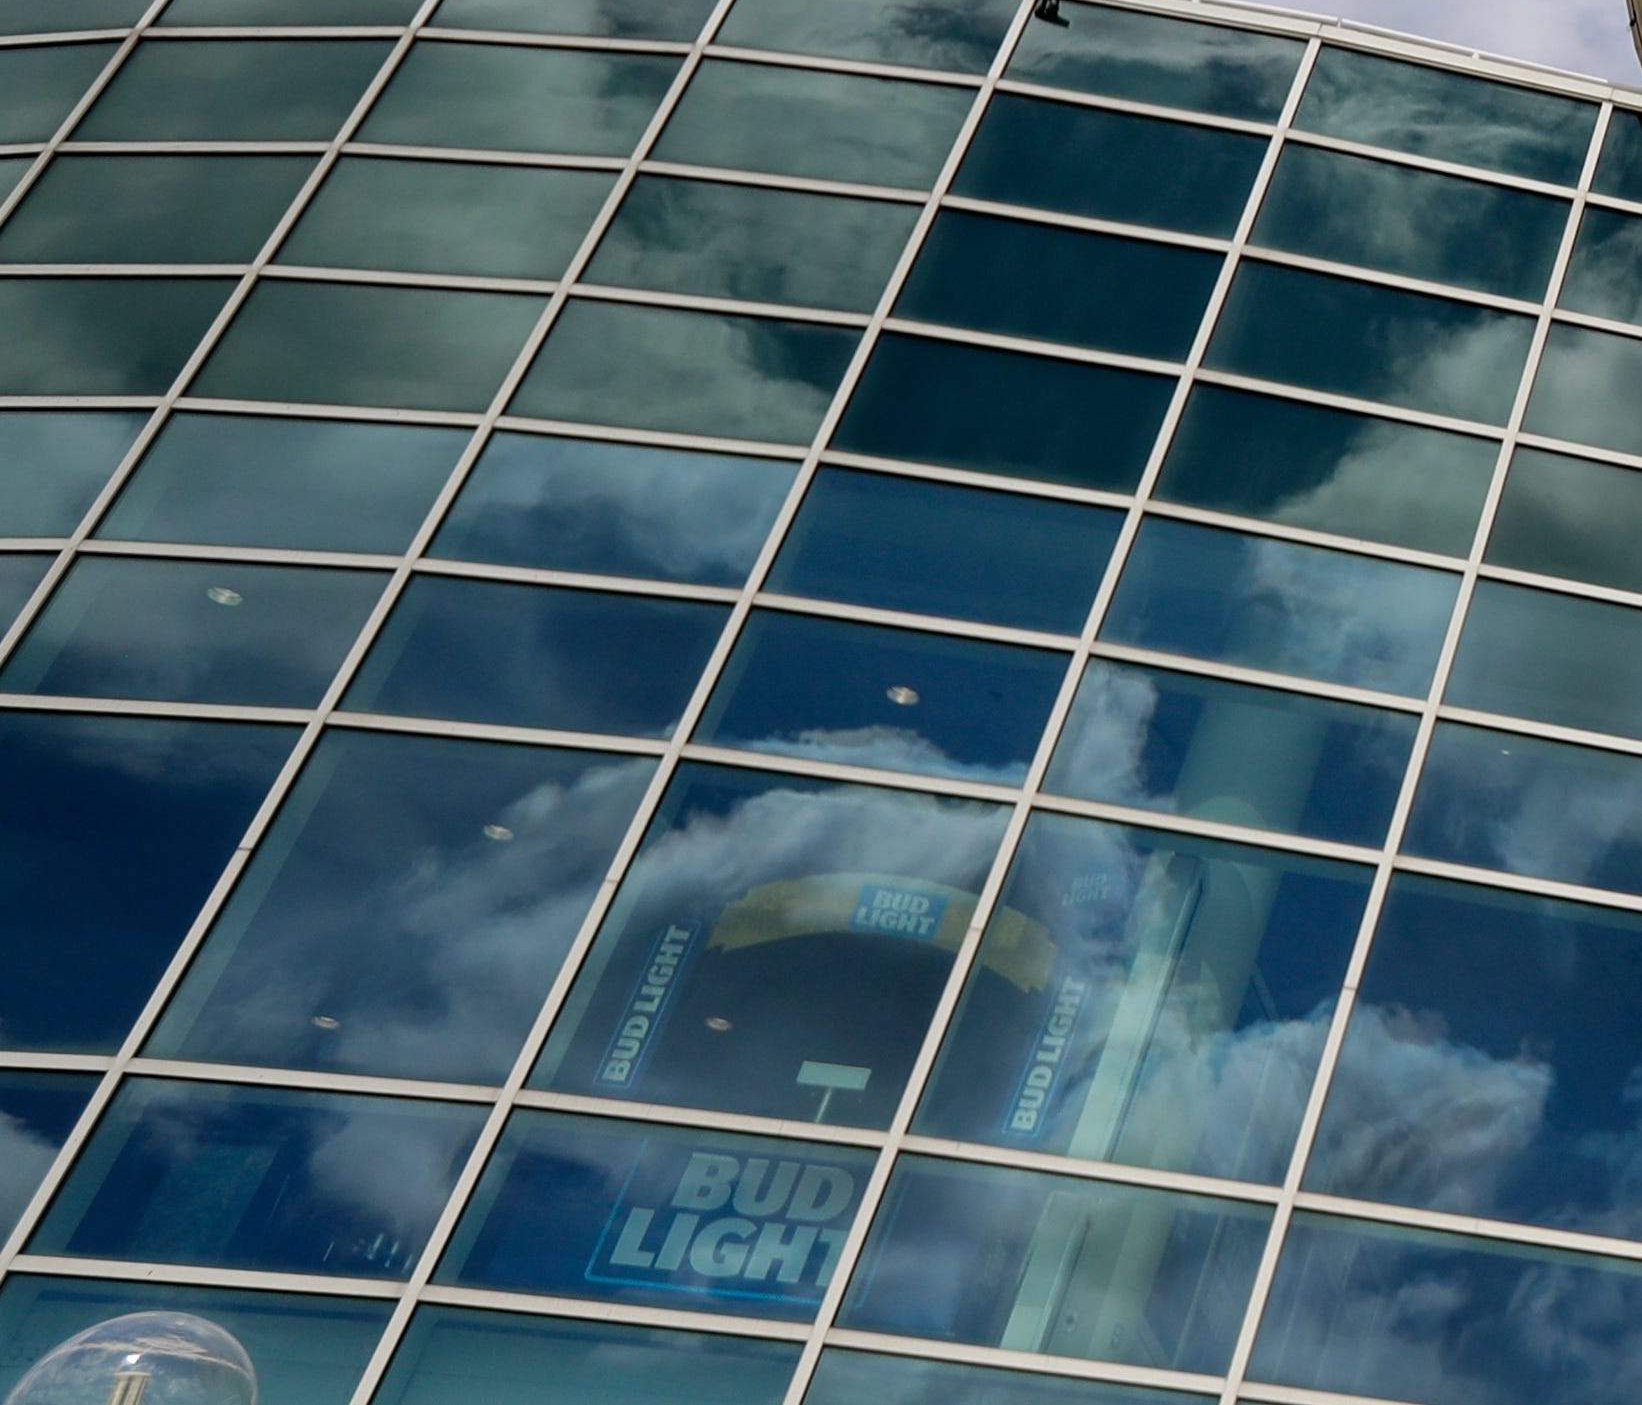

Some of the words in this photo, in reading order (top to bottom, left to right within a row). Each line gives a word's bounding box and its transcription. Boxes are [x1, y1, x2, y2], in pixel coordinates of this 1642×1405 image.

[855, 905, 936, 935] LIGHT
[872, 889, 931, 914] BUD
[602, 1015, 650, 1082] BUD
[633, 924, 691, 1013] LIGHT
[1010, 1065, 1053, 1131] BUD
[1035, 975, 1086, 1064] LIGHT
[671, 1152, 855, 1222] BUD
[609, 1207, 850, 1288] LIGHT
